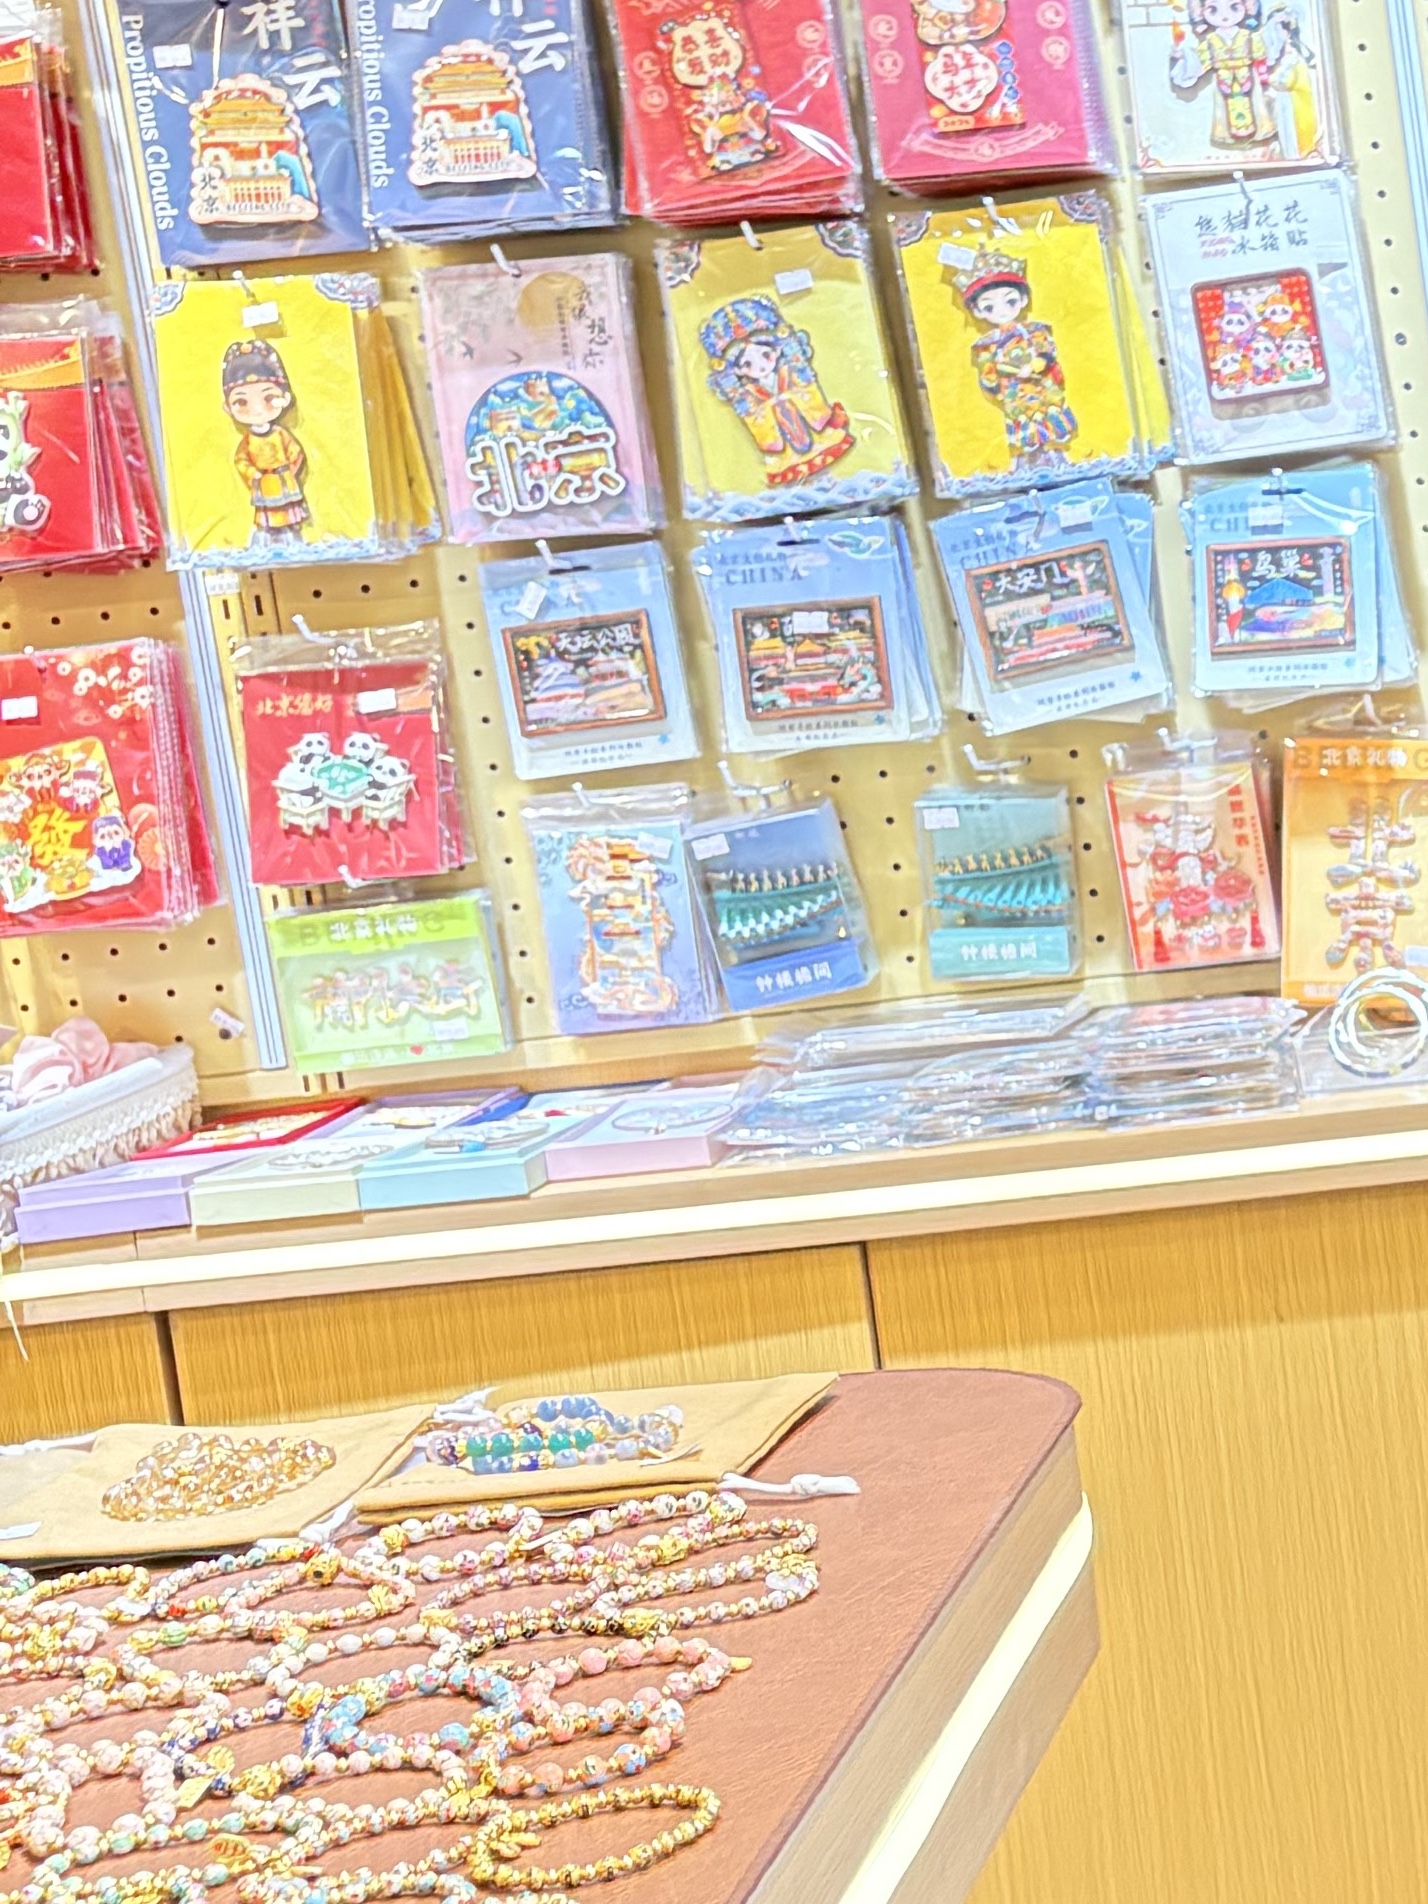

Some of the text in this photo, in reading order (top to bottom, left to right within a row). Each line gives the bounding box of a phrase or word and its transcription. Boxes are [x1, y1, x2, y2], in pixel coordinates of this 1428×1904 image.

[121, 14, 180, 230] Propitious Clouds
[368, 105, 393, 189] Clouds
[464, 424, 627, 517] 北京
[725, 565, 804, 585] CHINA
[994, 560, 1070, 594] 天安门
